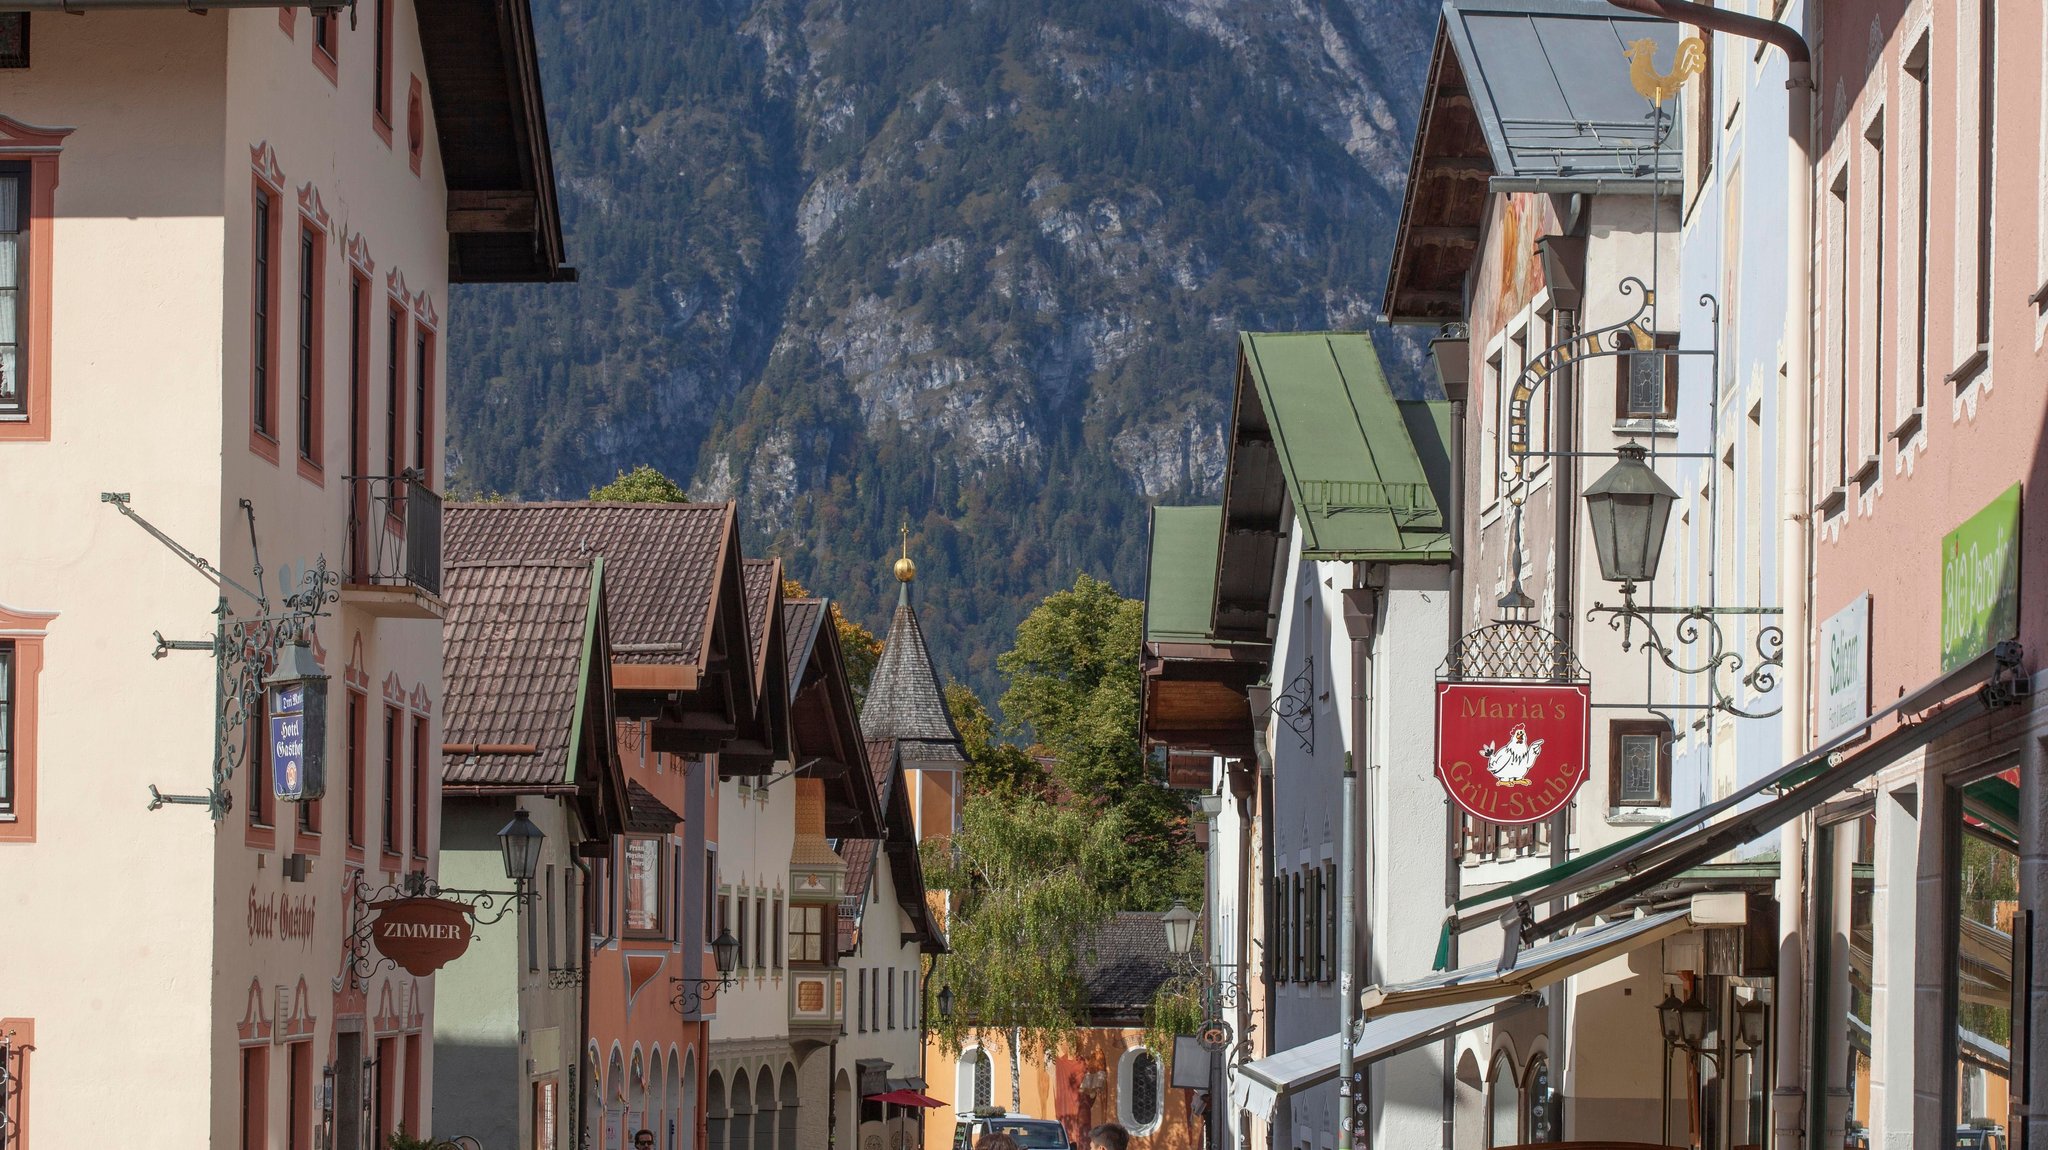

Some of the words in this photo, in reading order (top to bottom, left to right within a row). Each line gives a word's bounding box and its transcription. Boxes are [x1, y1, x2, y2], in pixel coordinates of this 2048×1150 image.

[1460, 696, 1566, 721] Maria's
[281, 721, 300, 740] Hotel
[1450, 760, 1577, 817] Grill-Stube
[383, 922, 462, 940] ZIMMER
